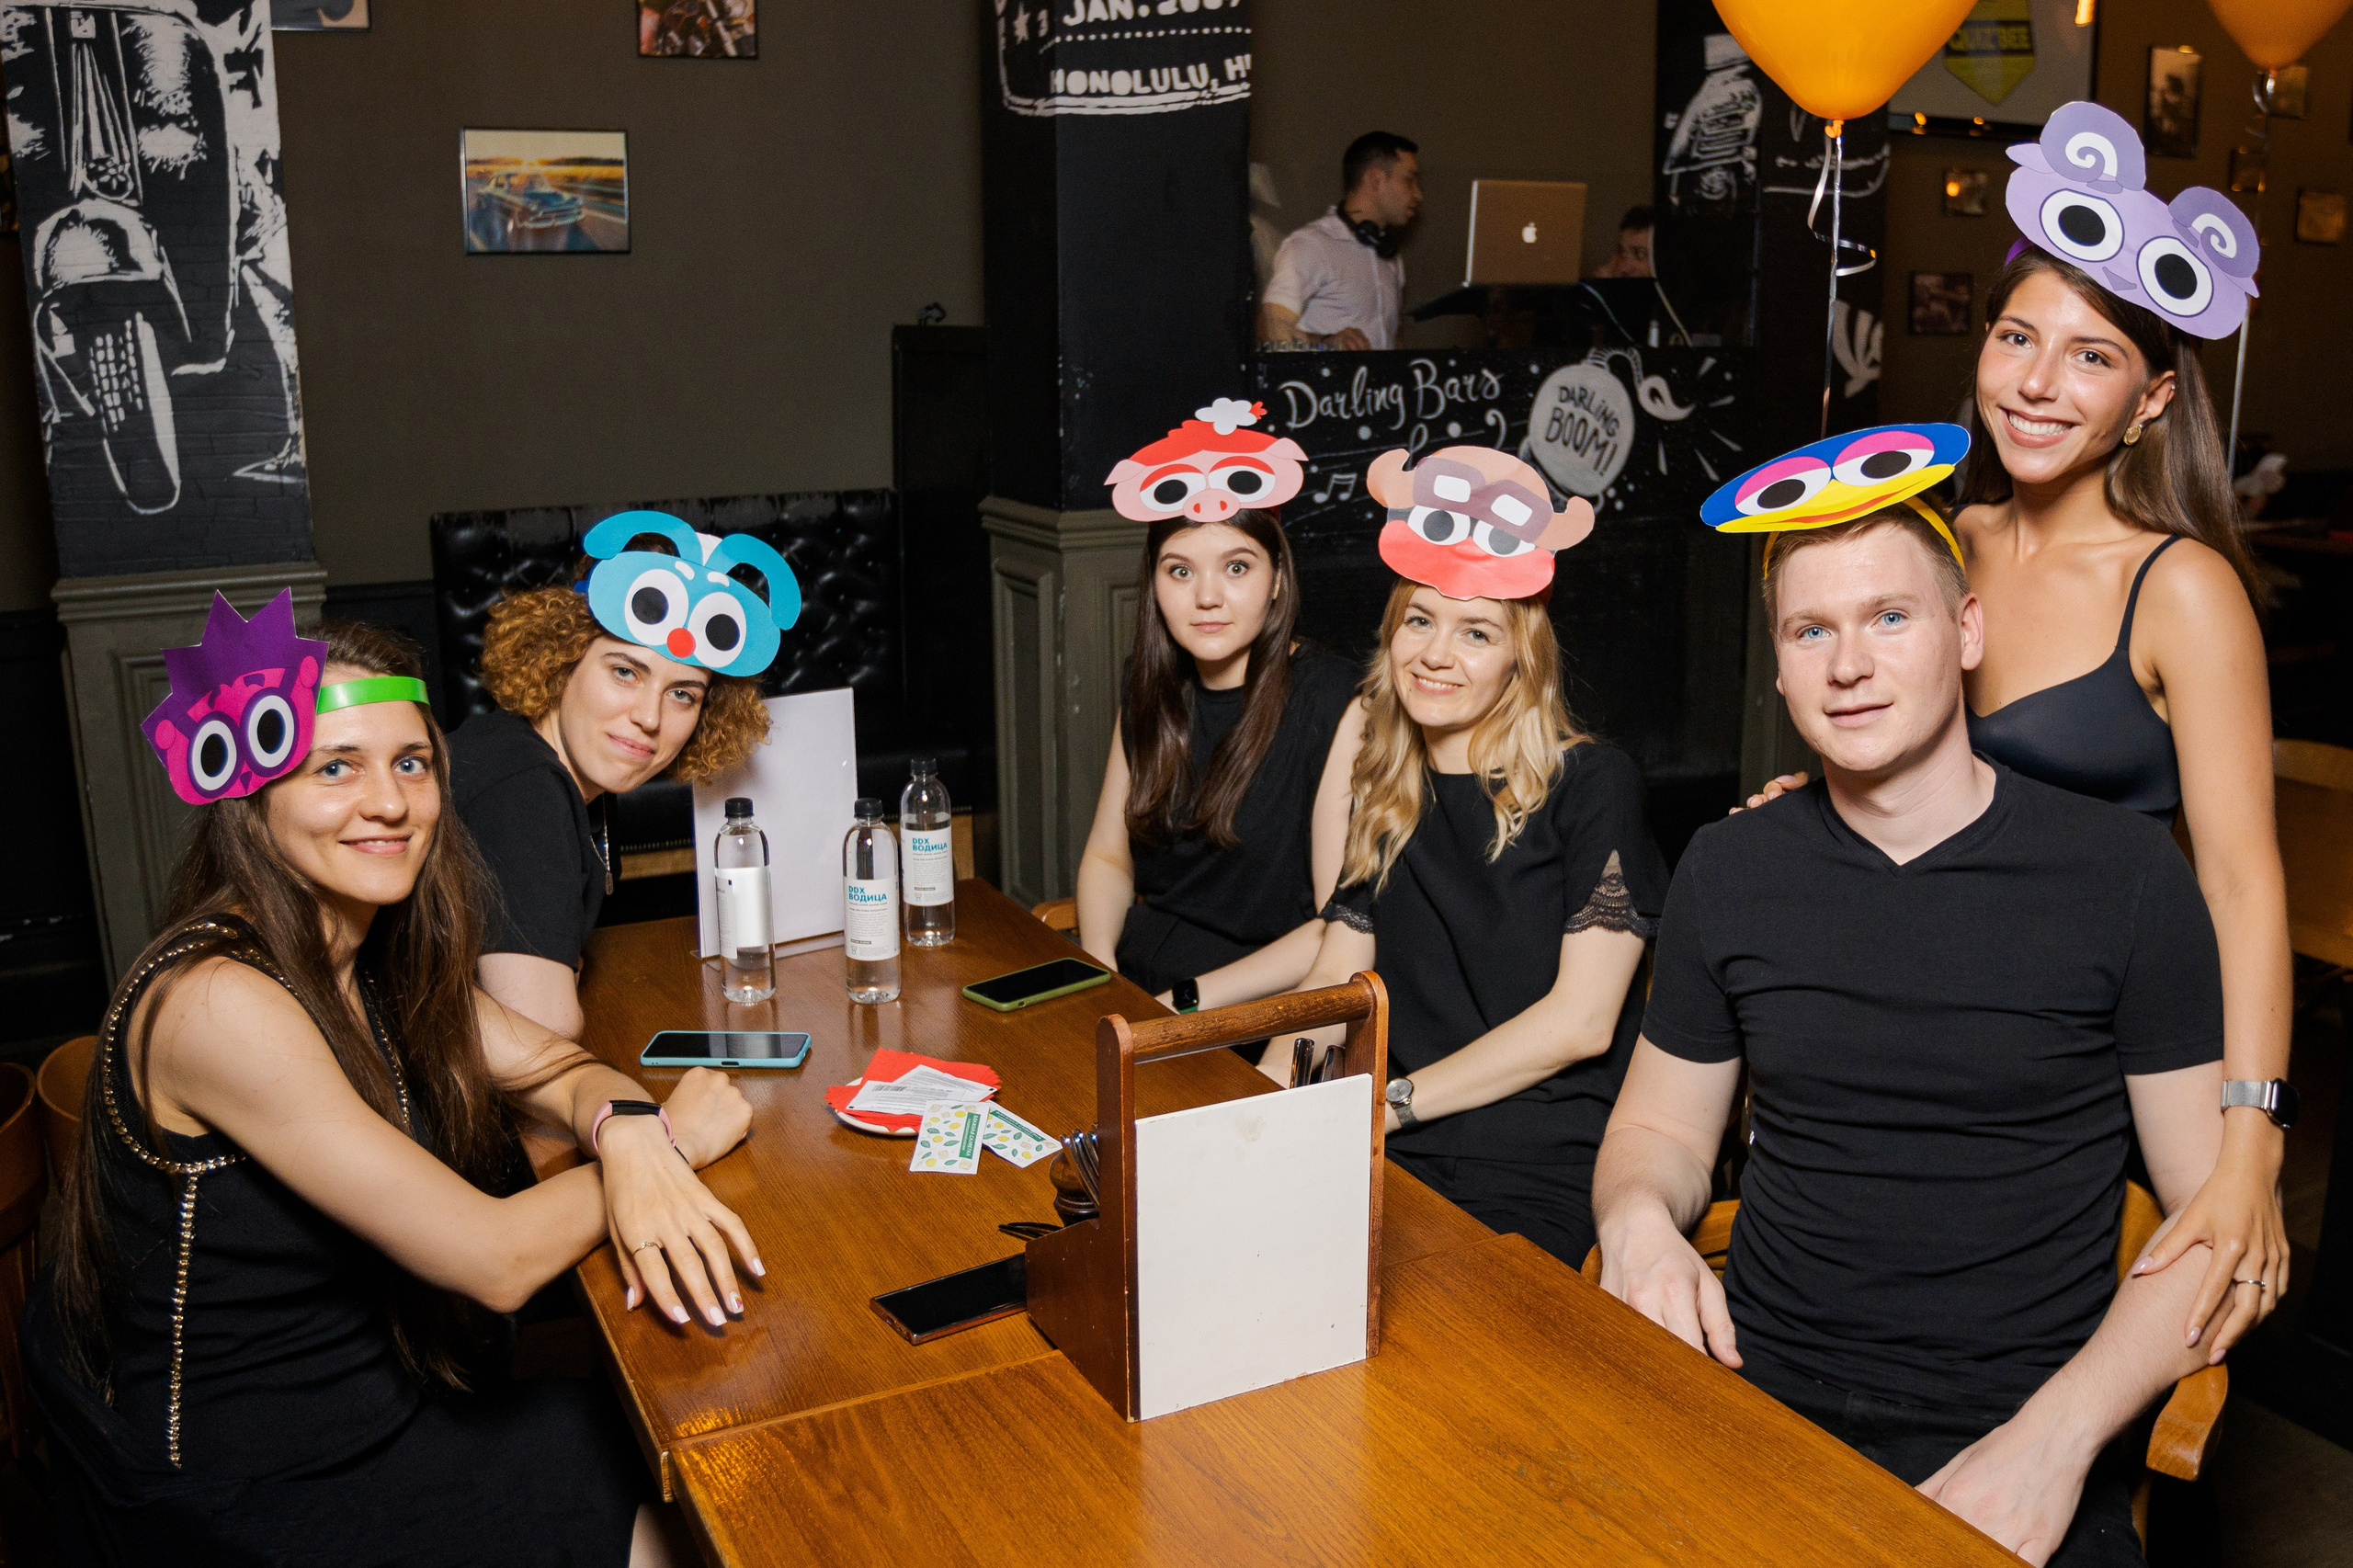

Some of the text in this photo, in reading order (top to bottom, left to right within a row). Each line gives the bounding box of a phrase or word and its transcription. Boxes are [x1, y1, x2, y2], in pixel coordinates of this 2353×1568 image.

[1051, 62, 1220, 96] HONOLULU,
[1278, 358, 1505, 431] Darling Bars
[1545, 406, 1618, 477] BOOM!
[912, 842, 948, 852] ВОДИЦА
[848, 885, 866, 894] DDX
[848, 892, 887, 903] ВОДИЦА
